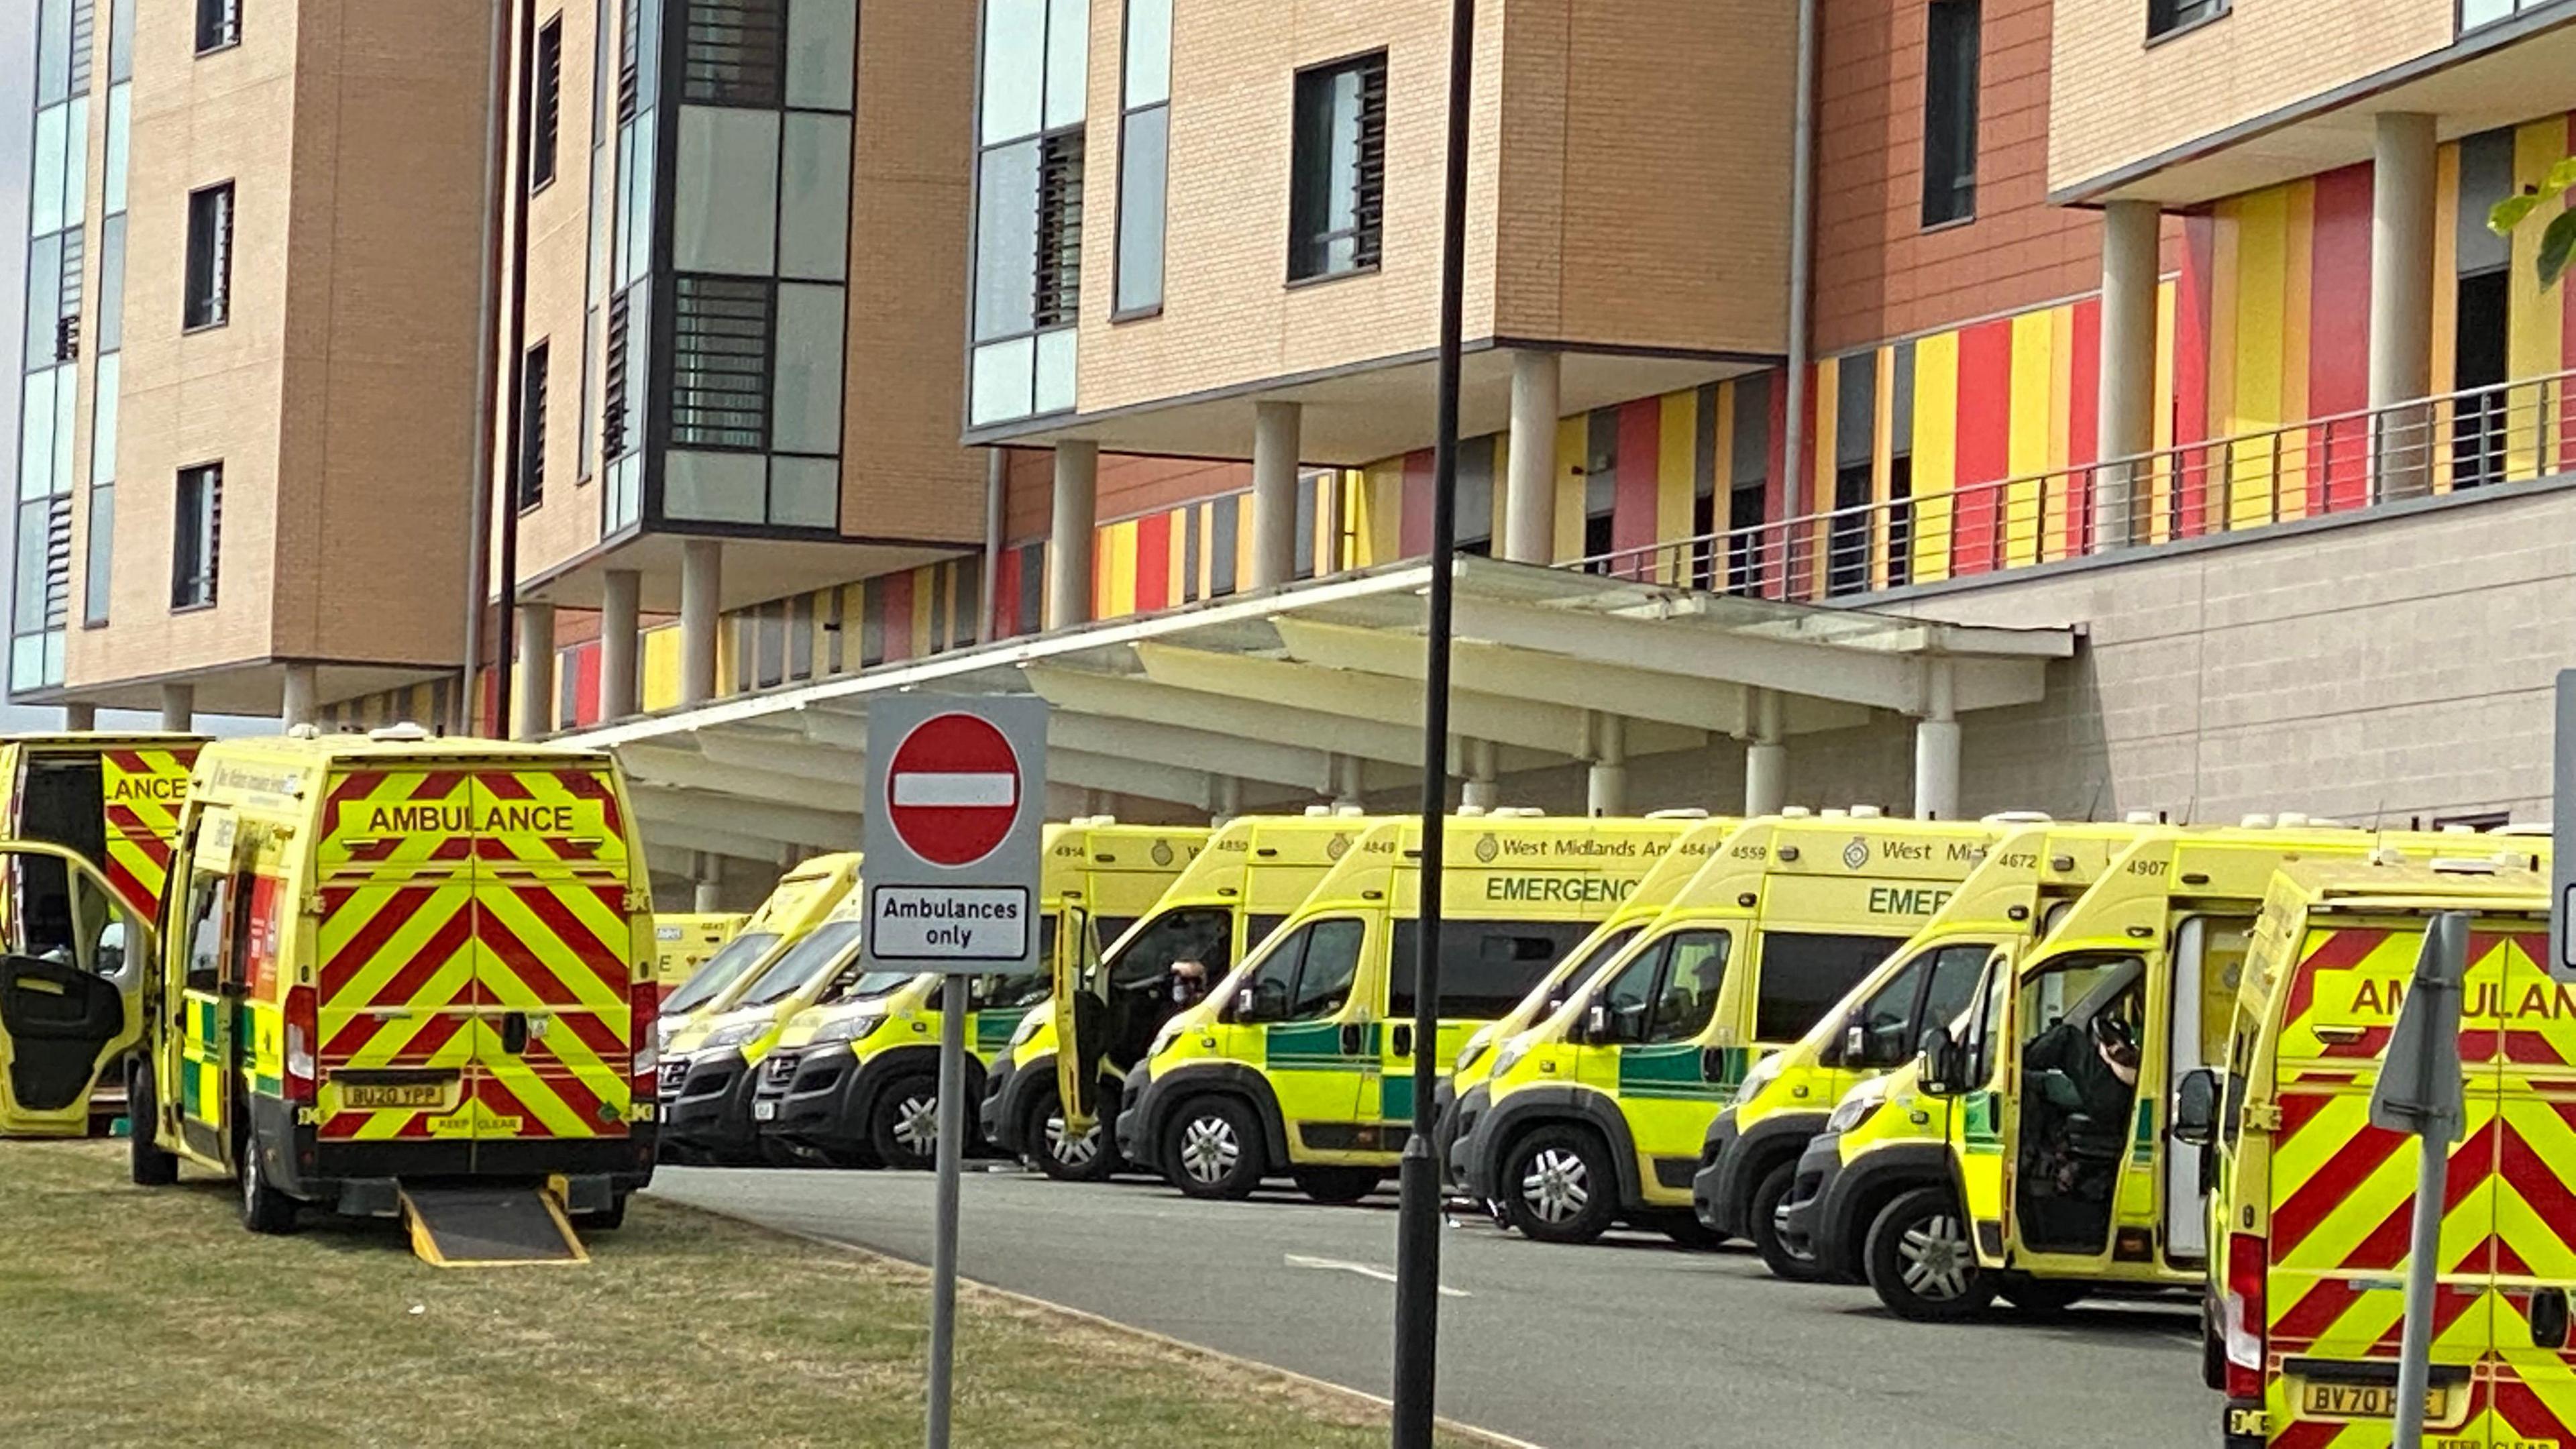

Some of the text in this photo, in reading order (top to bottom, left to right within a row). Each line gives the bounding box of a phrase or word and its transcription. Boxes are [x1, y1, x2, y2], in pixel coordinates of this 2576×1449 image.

[105, 778, 187, 800] ANCE
[368, 806, 574, 832] AMBULANCE
[1503, 839, 1547, 855] West
[1554, 839, 1635, 857] Midlands
[1731, 846, 1767, 860] 4559
[1882, 841, 1932, 859] West
[1999, 855, 2038, 869] 4672
[2127, 860, 2169, 875] 4907
[883, 897, 1018, 919] Ambulances
[926, 924, 972, 949] only
[2350, 979, 2576, 1020] AMULAN
[353, 1087, 436, 1106] BU20 YPP
[439, 1119, 517, 1130] KEEP CLEAR
[2315, 1387, 2378, 1412] BV70
